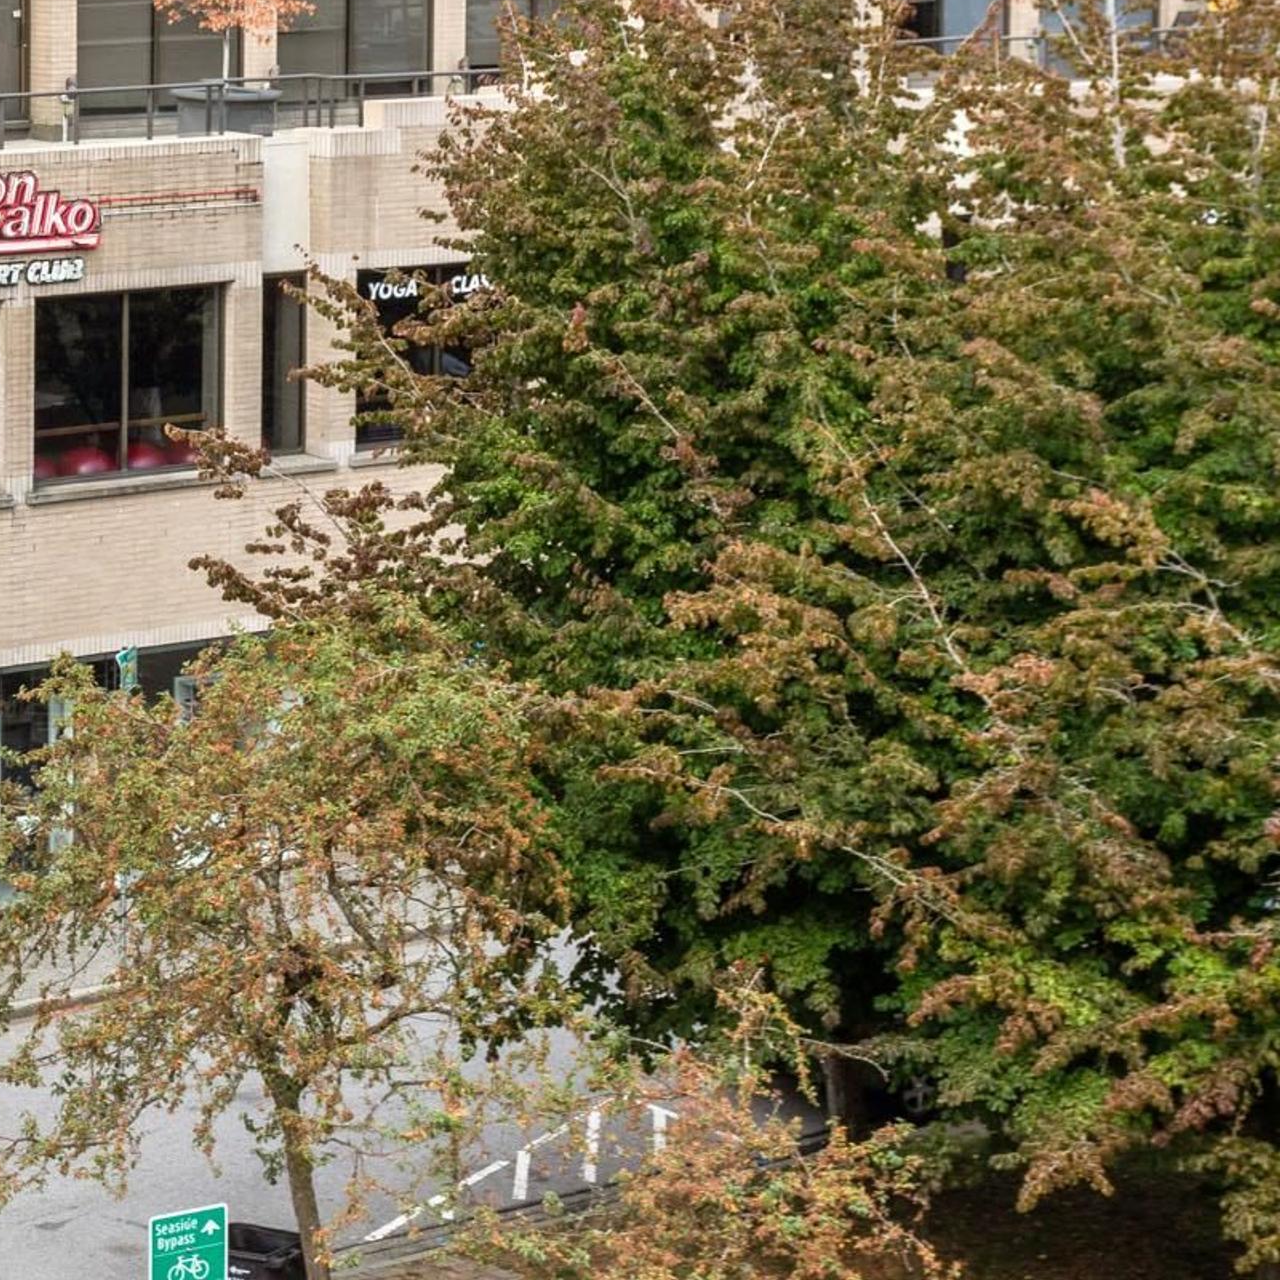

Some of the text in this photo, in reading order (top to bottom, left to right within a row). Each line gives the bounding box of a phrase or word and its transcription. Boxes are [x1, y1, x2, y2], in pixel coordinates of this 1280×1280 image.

[26, 258, 84, 285] CLUB
[368, 278, 418, 300] YOGA
[155, 1218, 198, 1237] Seaside
[157, 1233, 196, 1252] Bypass
